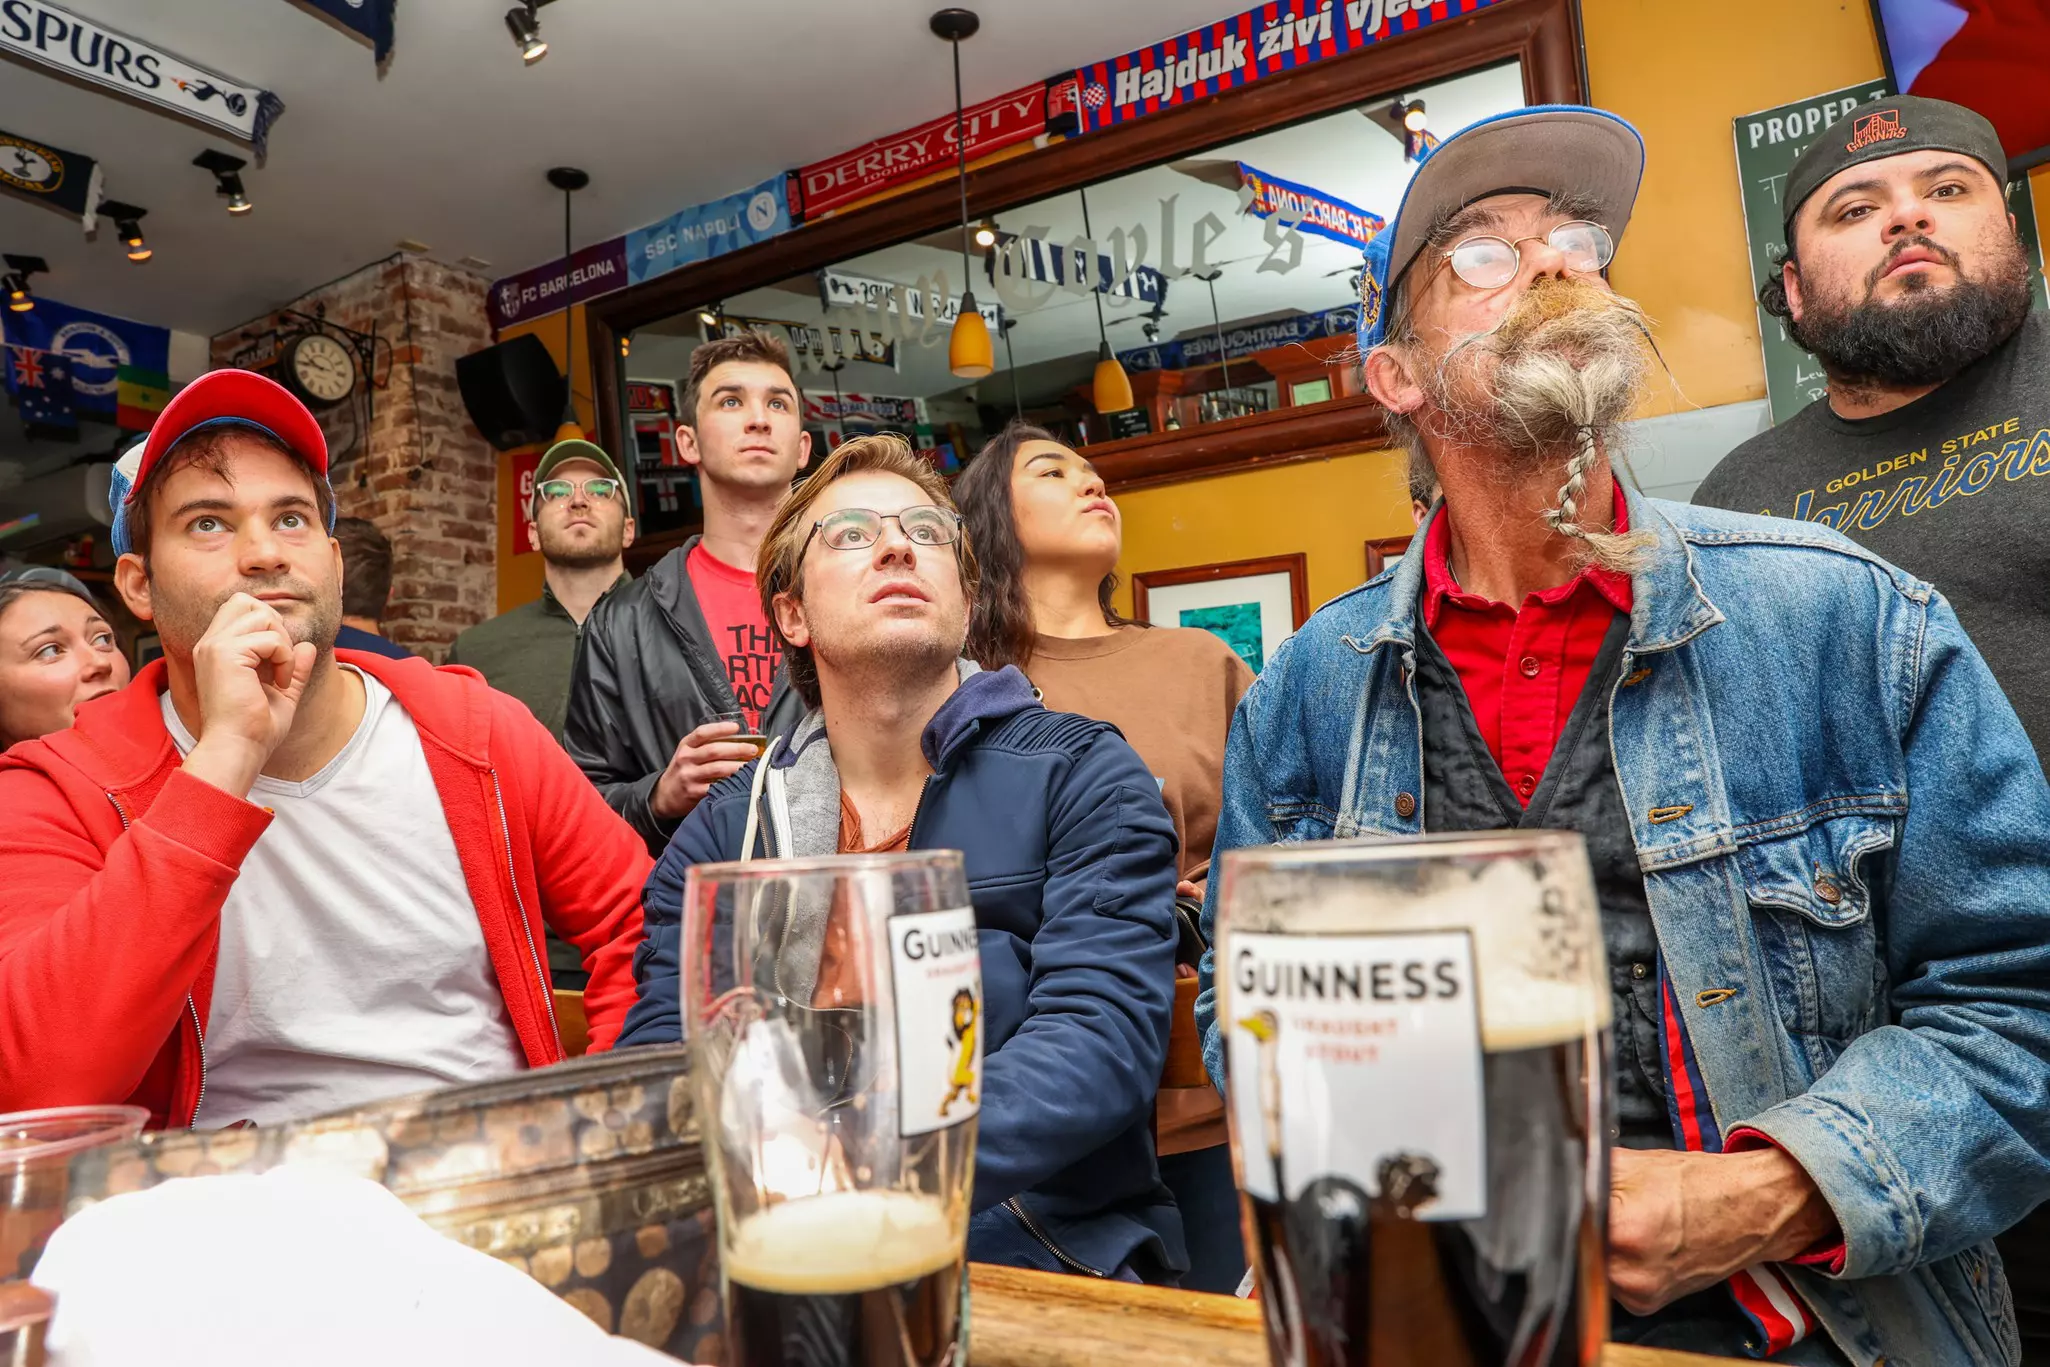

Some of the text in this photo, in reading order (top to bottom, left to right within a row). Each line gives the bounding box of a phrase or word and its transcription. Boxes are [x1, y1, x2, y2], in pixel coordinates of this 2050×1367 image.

[1, 0, 161, 90] SPURS
[1114, 36, 1247, 107] Hajduk
[1257, 4, 1333, 62] živi
[807, 96, 1037, 196] DERRY CITY
[1845, 126, 1909, 153] GIANTS
[863, 154, 934, 184] FOOTBALL
[644, 213, 741, 260] SSC NAPOLI
[521, 287, 537, 304] FC
[1826, 417, 2020, 493] GOLDEN STATE
[736, 682, 771, 712] AC
[1234, 946, 1462, 1001] GUINNESS
